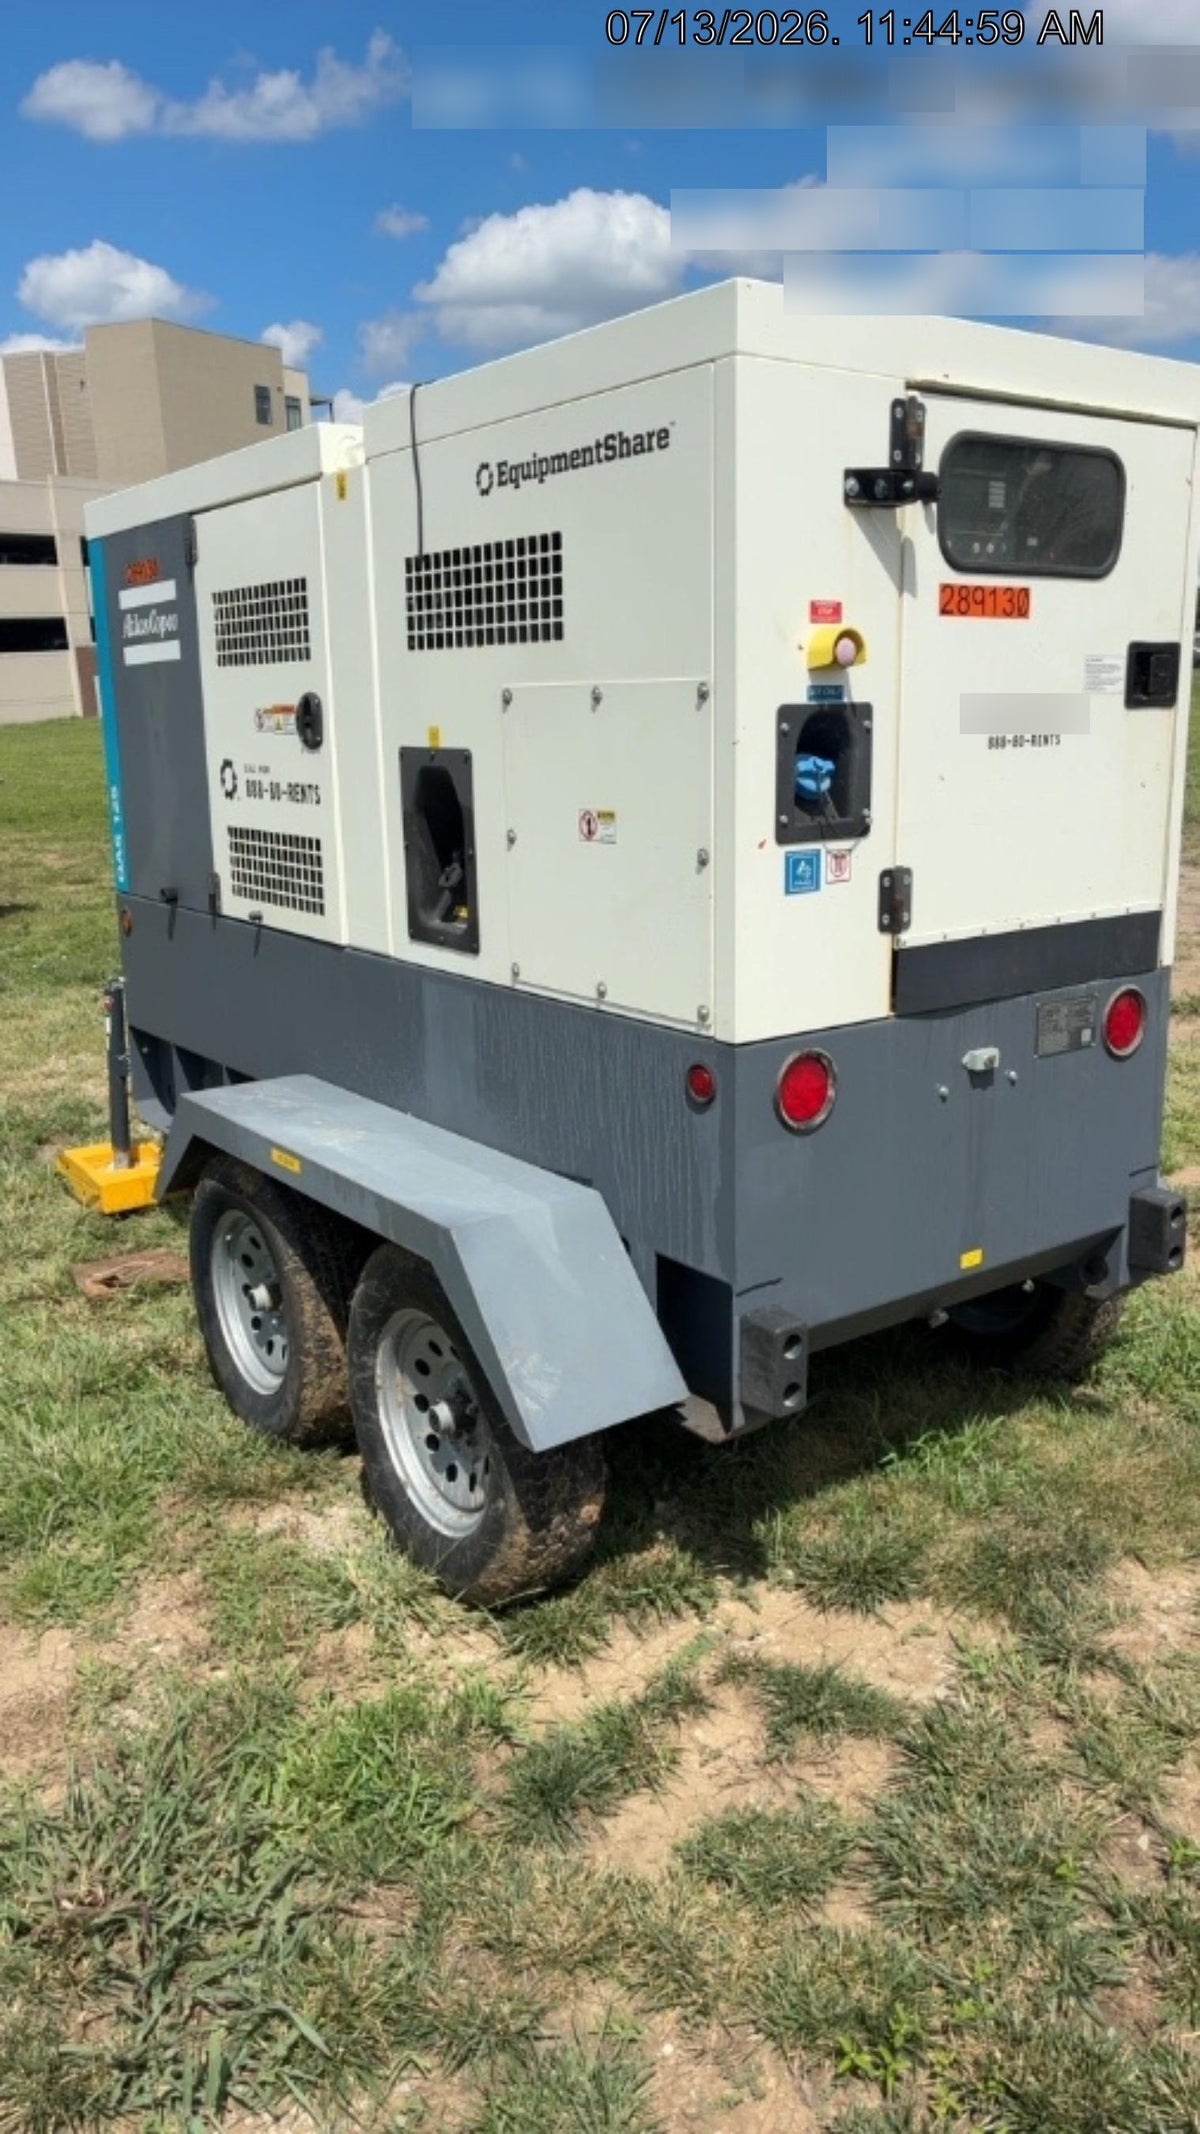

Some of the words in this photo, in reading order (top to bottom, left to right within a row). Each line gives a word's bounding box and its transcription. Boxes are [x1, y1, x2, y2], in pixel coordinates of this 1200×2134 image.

[496, 426, 670, 489] EquipmentShare
[940, 584, 1031, 619] 289130
[987, 733, 1062, 751] 888-80-RENTS
[246, 779, 321, 805] 888-80-RENTS
